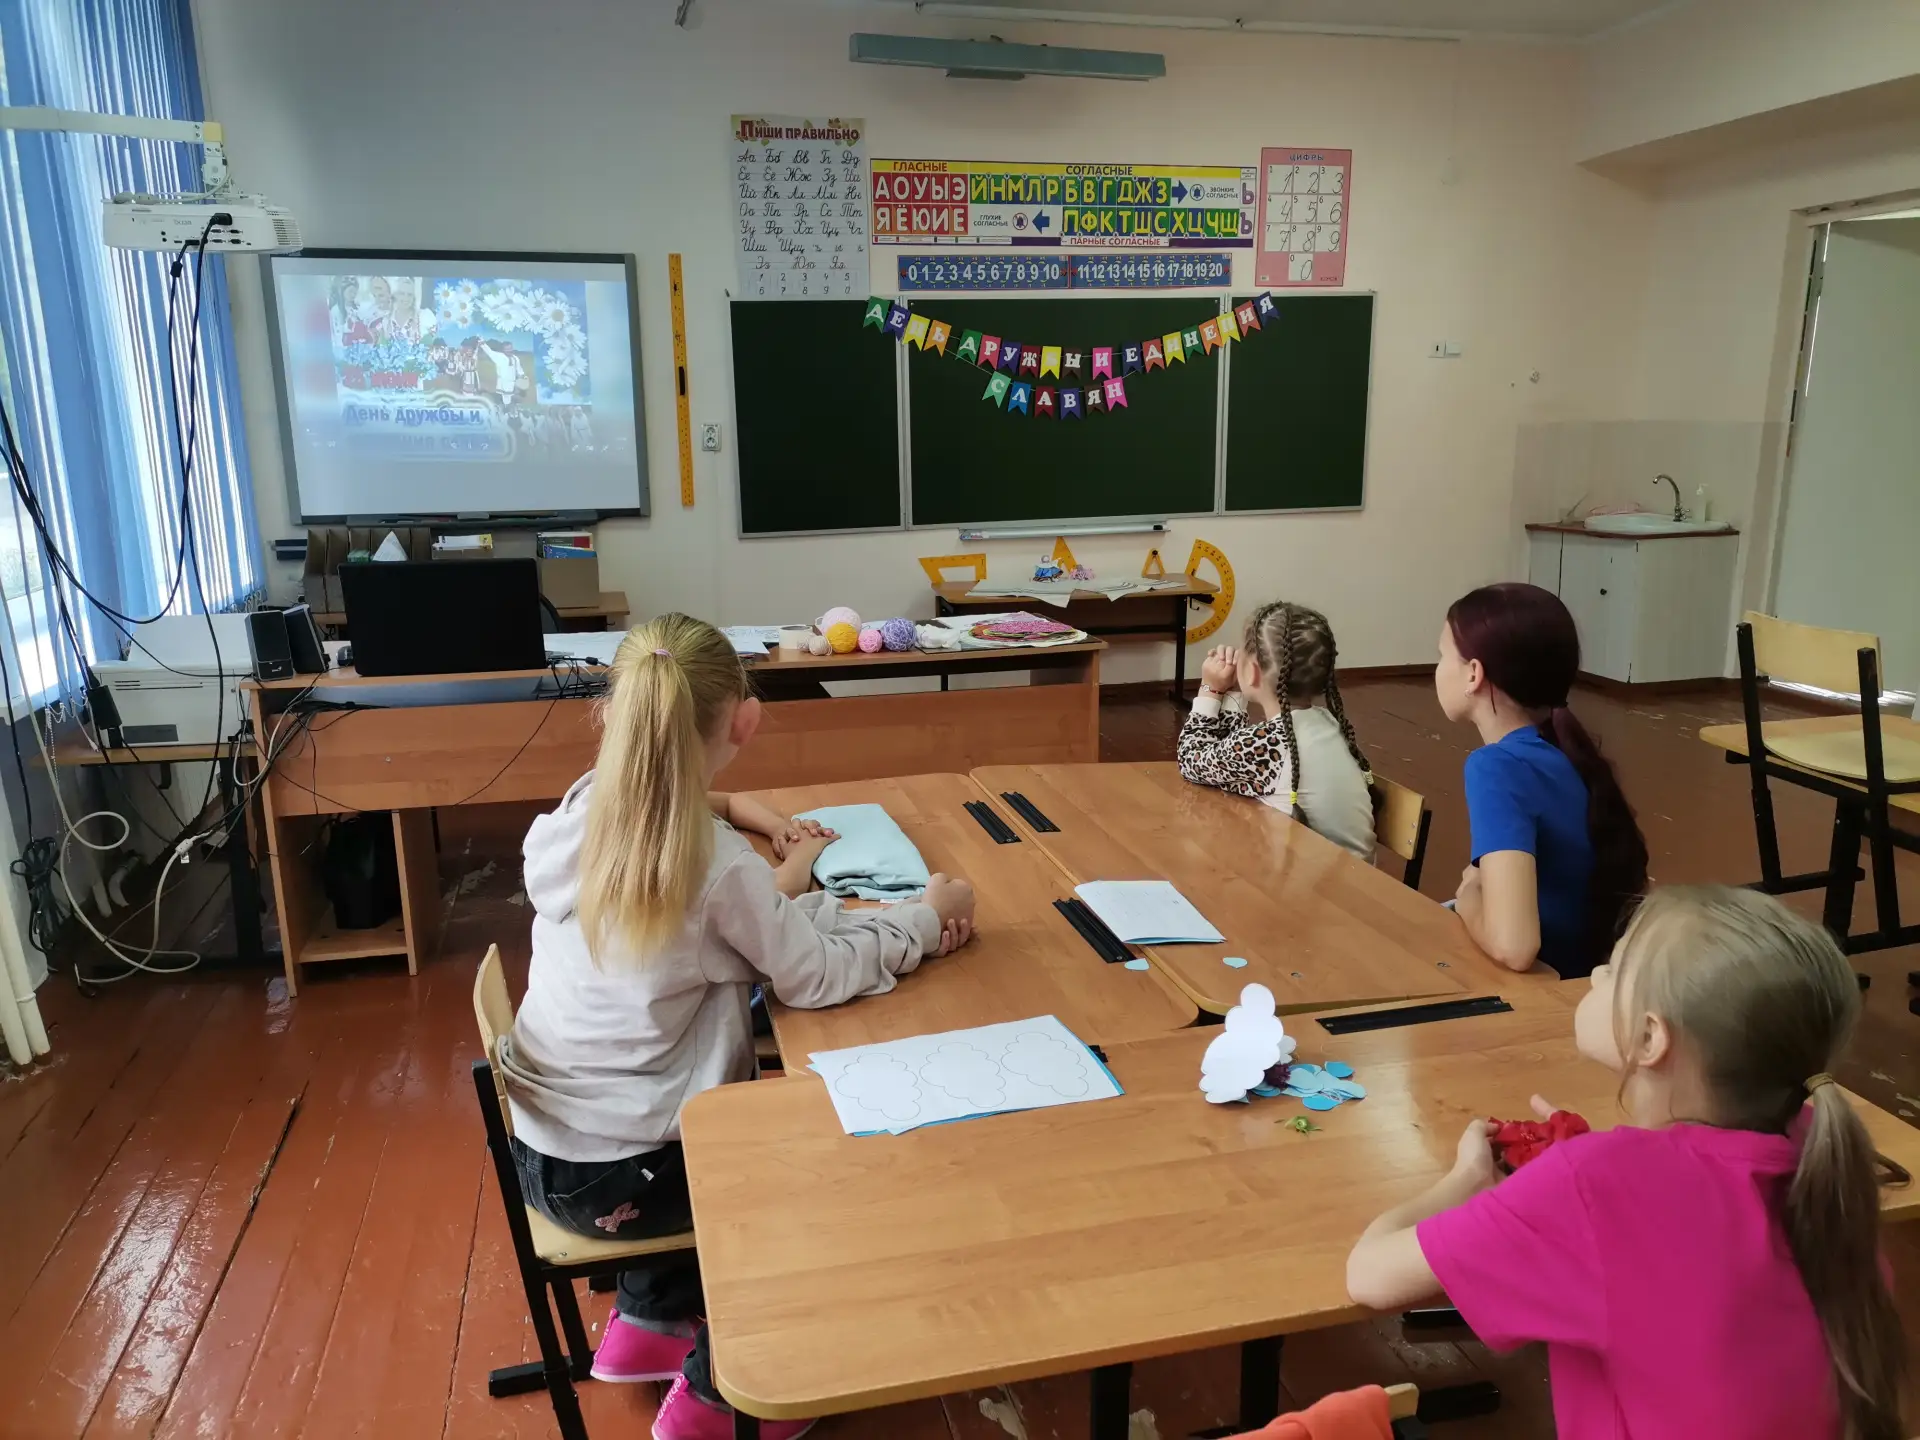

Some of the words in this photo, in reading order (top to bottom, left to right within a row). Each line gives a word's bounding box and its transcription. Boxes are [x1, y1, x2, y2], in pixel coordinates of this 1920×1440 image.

[893, 162, 948, 172] ГЛАСНЫЕ
[1066, 166, 1133, 176] СОГЛАСНЫЕ
[1284, 172, 1293, 193] 1
[1295, 166, 1300, 174] 2
[1307, 172, 1318, 194] 2
[1332, 173, 1344, 194] 3
[1281, 201, 1292, 222] 4
[1305, 202, 1317, 222] 5
[1330, 202, 1342, 223] 6
[1109, 238, 1160, 246] СОГЛАСНЫЕ
[1280, 230, 1291, 251] 7
[1303, 231, 1315, 252] 8
[1328, 231, 1340, 252] 9
[781, 273, 786, 281] 2
[803, 273, 807, 281] 3
[909, 265, 917, 281] 0
[922, 265, 928, 280] 1
[935, 265, 944, 280] 2
[950, 265, 958, 280] 3
[963, 265, 972, 280] 4
[978, 265, 986, 280] 5
[991, 264, 1000, 280] 6
[1004, 265, 1012, 280] 7
[1017, 264, 1025, 280] 8
[1030, 264, 1039, 280] 9
[1044, 264, 1059, 280] 10
[1078, 264, 1089, 279] 11
[1092, 264, 1104, 278] 12
[1107, 264, 1120, 278] 13
[1122, 264, 1136, 278] 14
[1138, 264, 1150, 278] 15
[1153, 264, 1165, 278] 16
[1168, 263, 1180, 278] 17
[1181, 263, 1193, 277] 18
[1195, 263, 1207, 277] 19
[1209, 263, 1222, 277] 20
[1301, 260, 1312, 280] 0
[760, 287, 764, 295] 6
[866, 304, 945, 342] ДЕНЬ
[959, 336, 1082, 368] ДРУЖБЫ
[1096, 352, 1108, 367] И
[992, 378, 1122, 408] СЛАВЯН
[395, 405, 464, 425] дружбы
[470, 410, 480, 422] и
